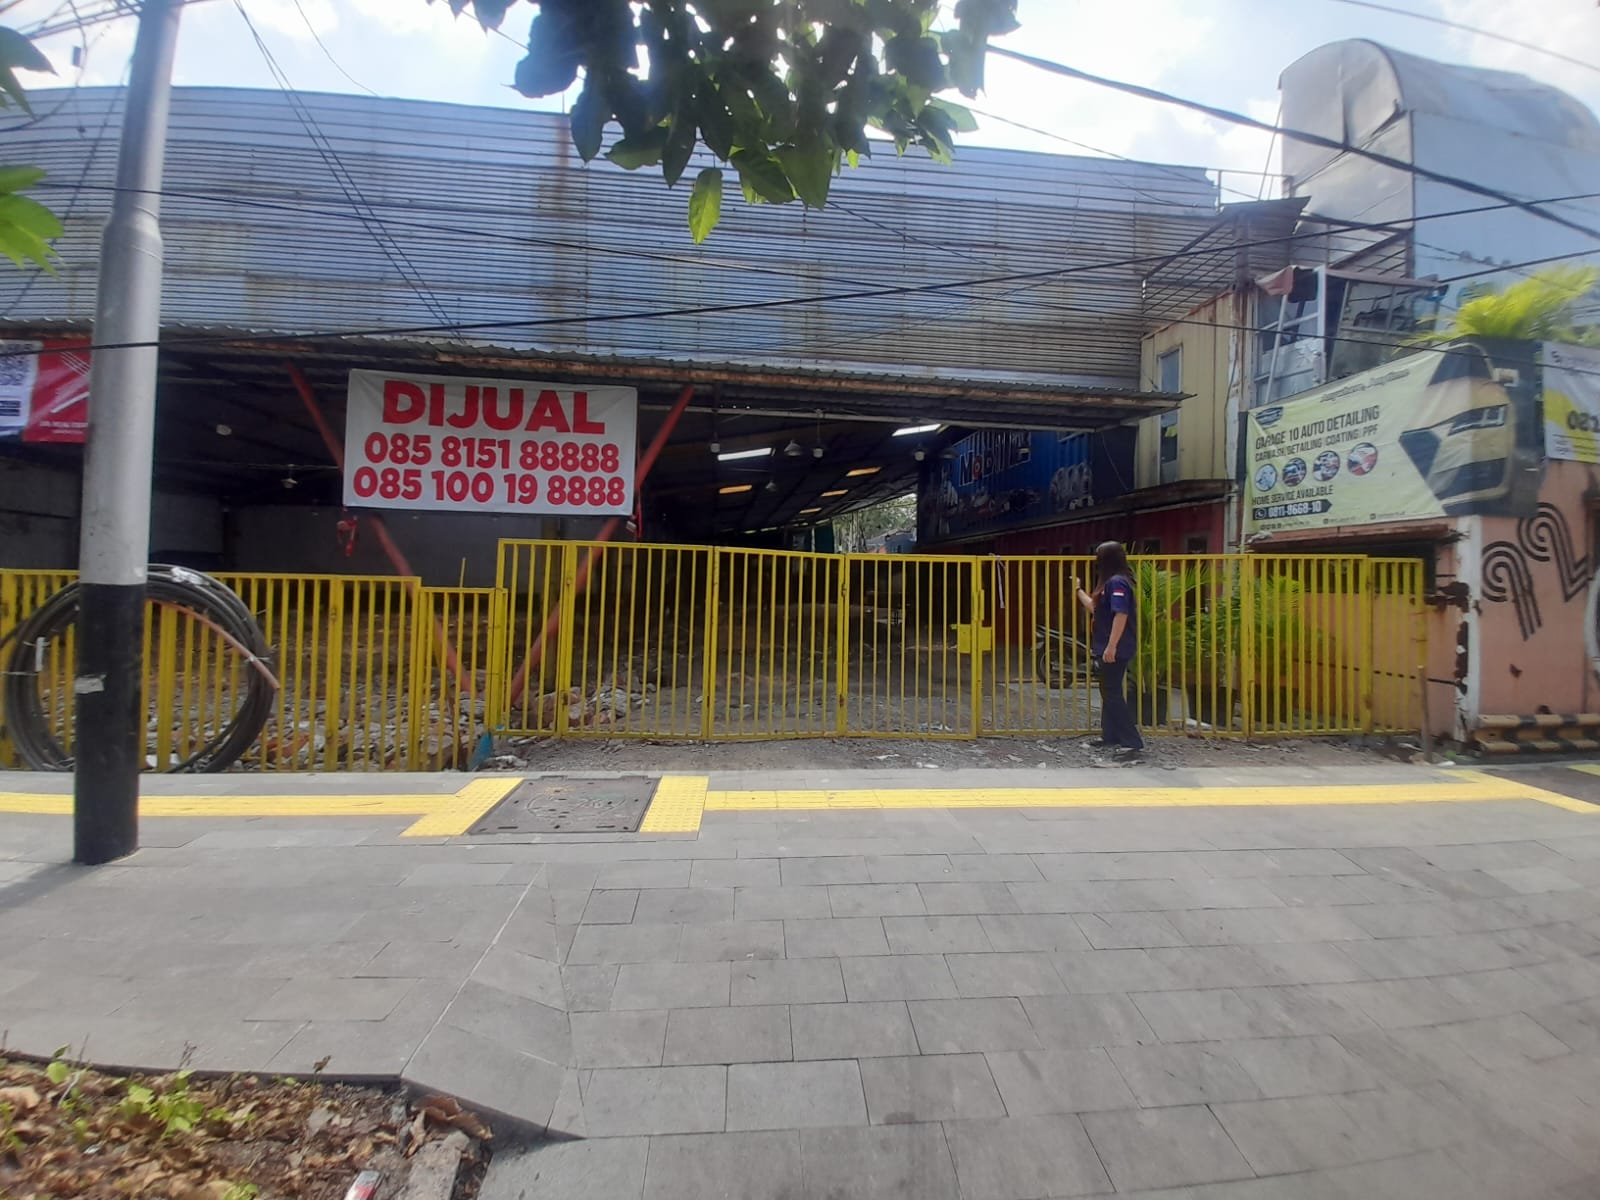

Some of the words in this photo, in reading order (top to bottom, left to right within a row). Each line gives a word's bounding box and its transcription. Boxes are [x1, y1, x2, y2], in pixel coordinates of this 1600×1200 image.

[382, 380, 606, 435] DIJUAL
[1255, 430, 1286, 450] GARAGE
[1289, 428, 1299, 441] 10
[1300, 420, 1325, 438] AUTO
[1327, 405, 1380, 432] DETAILING
[364, 431, 432, 466] 085
[441, 436, 511, 469] 8151
[519, 440, 620, 474] 88888
[353, 466, 423, 500] 085
[431, 470, 495, 503] 100
[503, 473, 539, 505] 19
[547, 474, 625, 507] 8888
[1296, 484, 1333, 499] AVAILABLE
